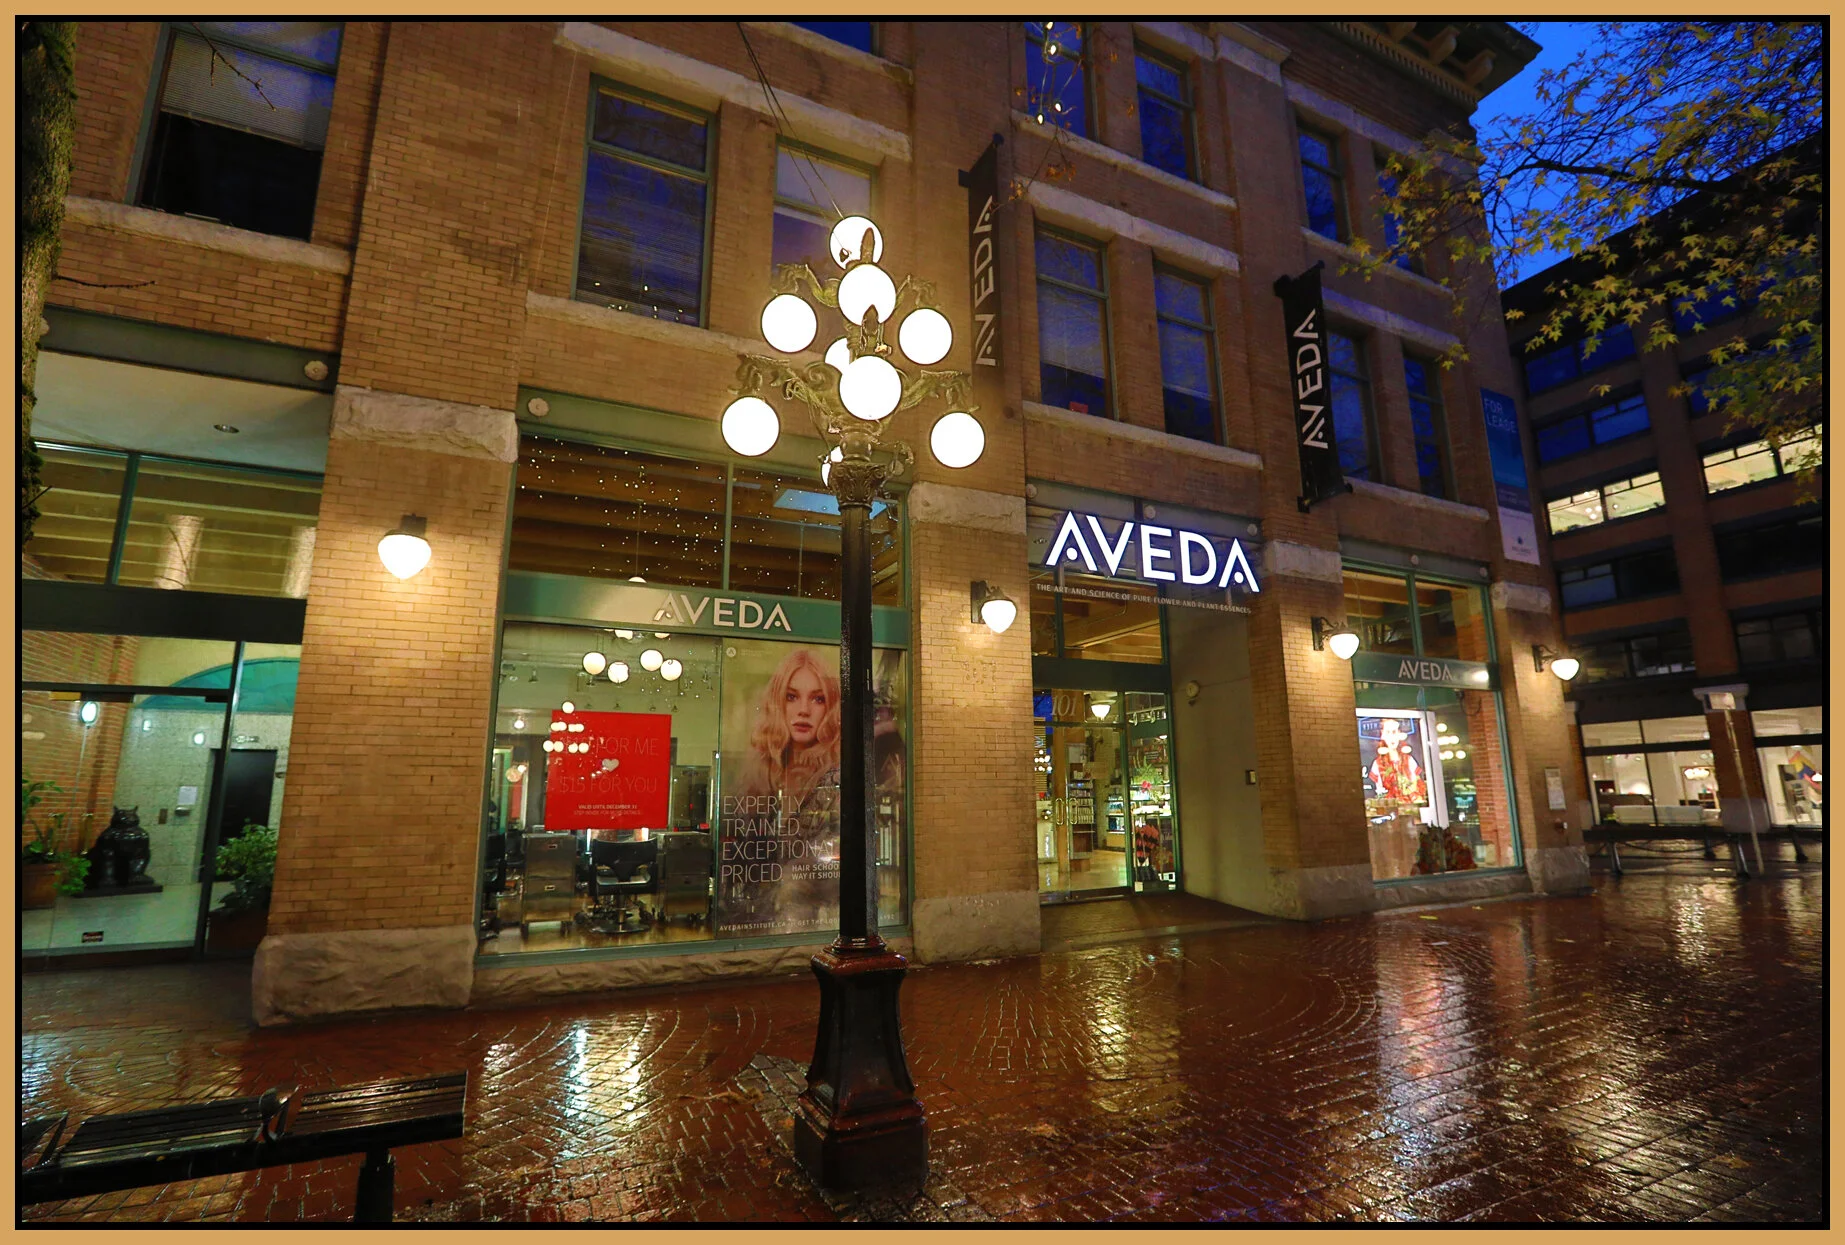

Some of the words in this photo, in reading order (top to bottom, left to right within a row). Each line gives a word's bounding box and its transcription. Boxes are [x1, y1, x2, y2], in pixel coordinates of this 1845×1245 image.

[973, 195, 996, 367] AVEDA
[1293, 308, 1329, 450] AVEDA
[1484, 397, 1504, 414] FOR
[1486, 413, 1517, 433] LEASE
[1045, 511, 1260, 593] AVEDA
[1036, 583, 1051, 592] THE
[1054, 585, 1068, 593] ART
[1071, 587, 1087, 596] AND
[1089, 589, 1120, 600] SCIENCE
[1121, 592, 1131, 601] OF
[1133, 594, 1151, 603] PURE
[1153, 596, 1181, 606] FLOWER
[1182, 600, 1196, 608] AND
[1197, 602, 1220, 610] PLANT
[1220, 604, 1251, 615] ESSENCES
[653, 593, 792, 632] AVEDA
[1398, 659, 1453, 681] AVEDA
[1050, 694, 1078, 717] 101
[634, 738, 659, 756] ME
[590, 776, 622, 793] FOR
[625, 776, 657, 793] YOU
[723, 795, 806, 815] EXPERTLY
[722, 817, 801, 837] TRAINED.
[721, 863, 784, 883] PRICED.
[791, 864, 810, 872] HAIR
[812, 863, 840, 872] SCHOO
[791, 872, 807, 880] WAY
[808, 872, 816, 880] IT
